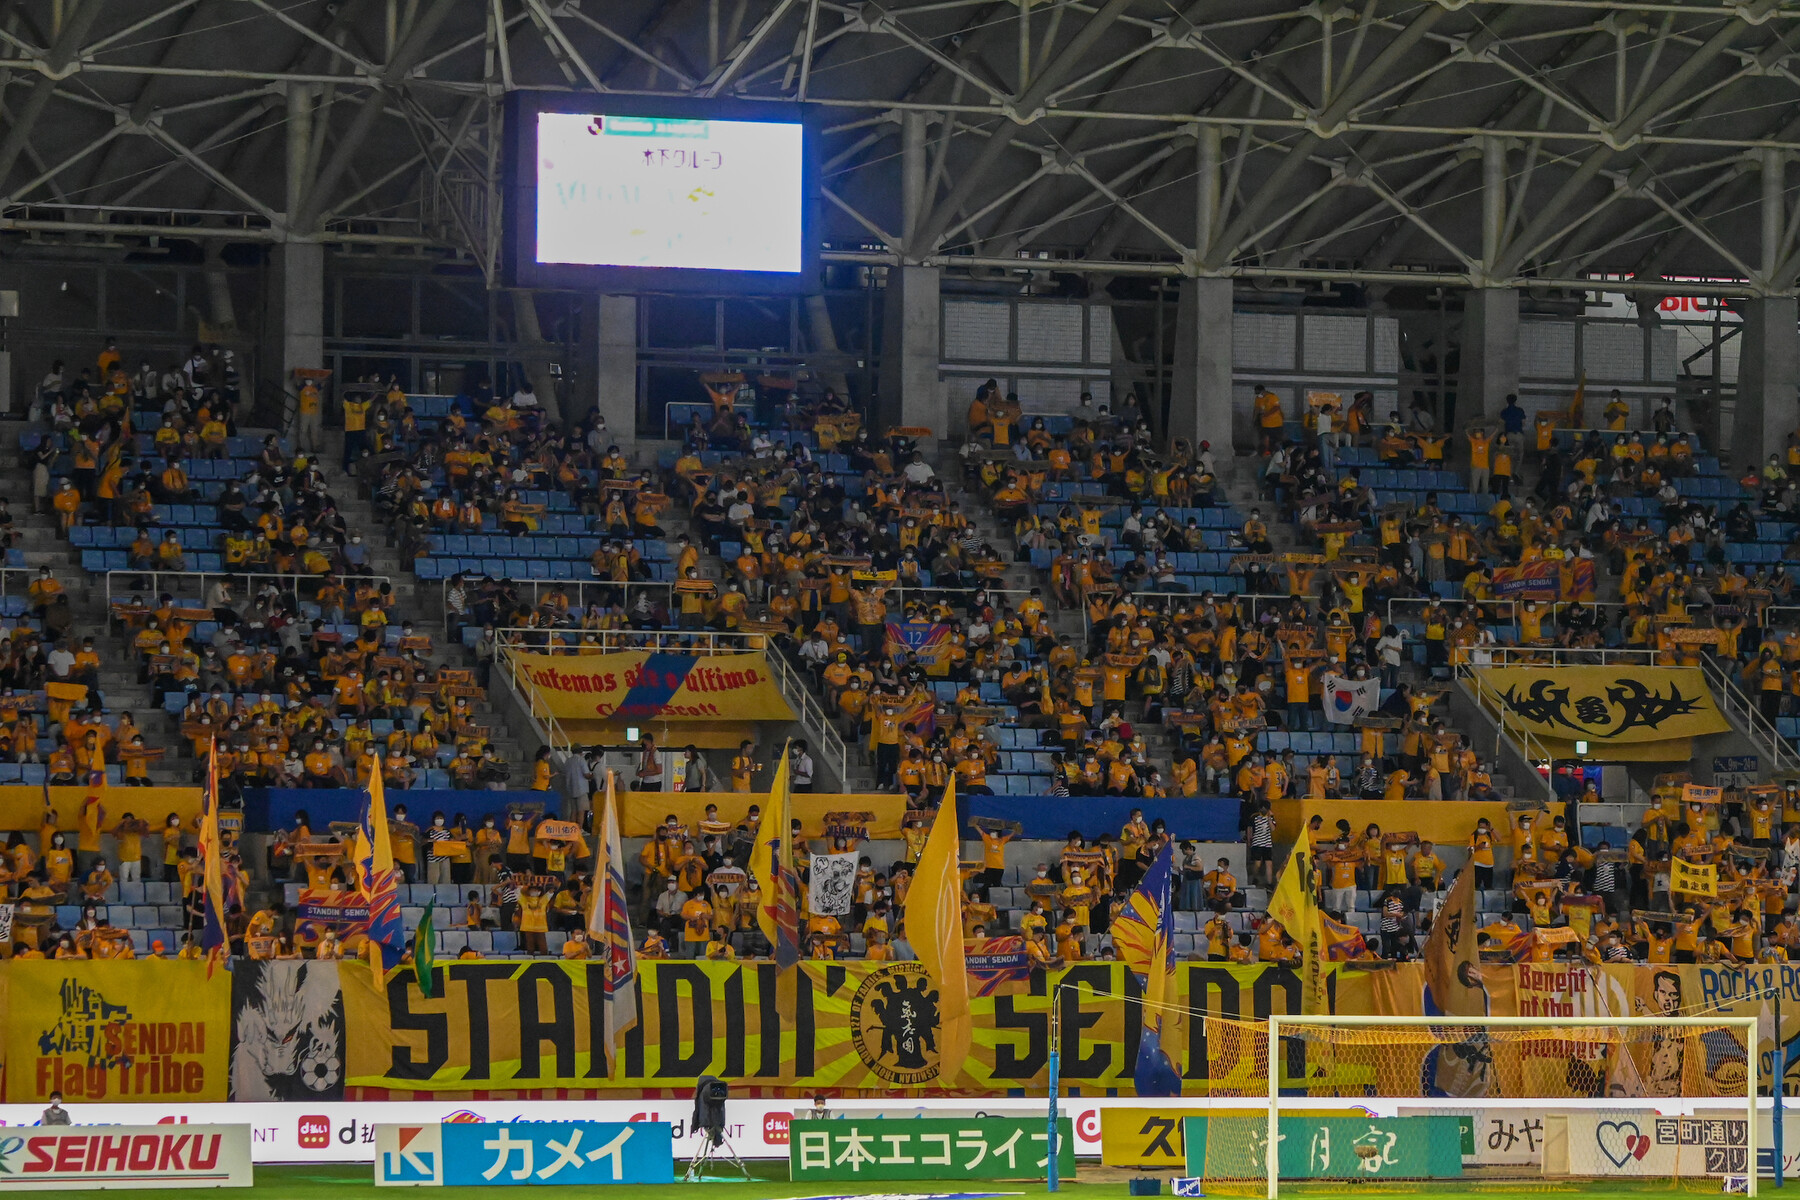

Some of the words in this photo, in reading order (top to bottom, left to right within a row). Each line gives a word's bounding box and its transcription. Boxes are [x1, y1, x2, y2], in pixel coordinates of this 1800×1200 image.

[909, 631, 922, 645] 12
[1518, 963, 1587, 997] Benefit
[1699, 966, 1762, 1012] ROCK
[104, 1021, 206, 1055] SENDAI
[36, 1055, 107, 1100] Flag
[120, 1054, 205, 1097] Tribe
[800, 1127, 1064, 1173] 日本エコライフ
[1657, 1119, 1748, 1146] 宮町通り
[22, 1133, 222, 1173] SEIHOKU
[481, 1125, 636, 1182] カメイ
